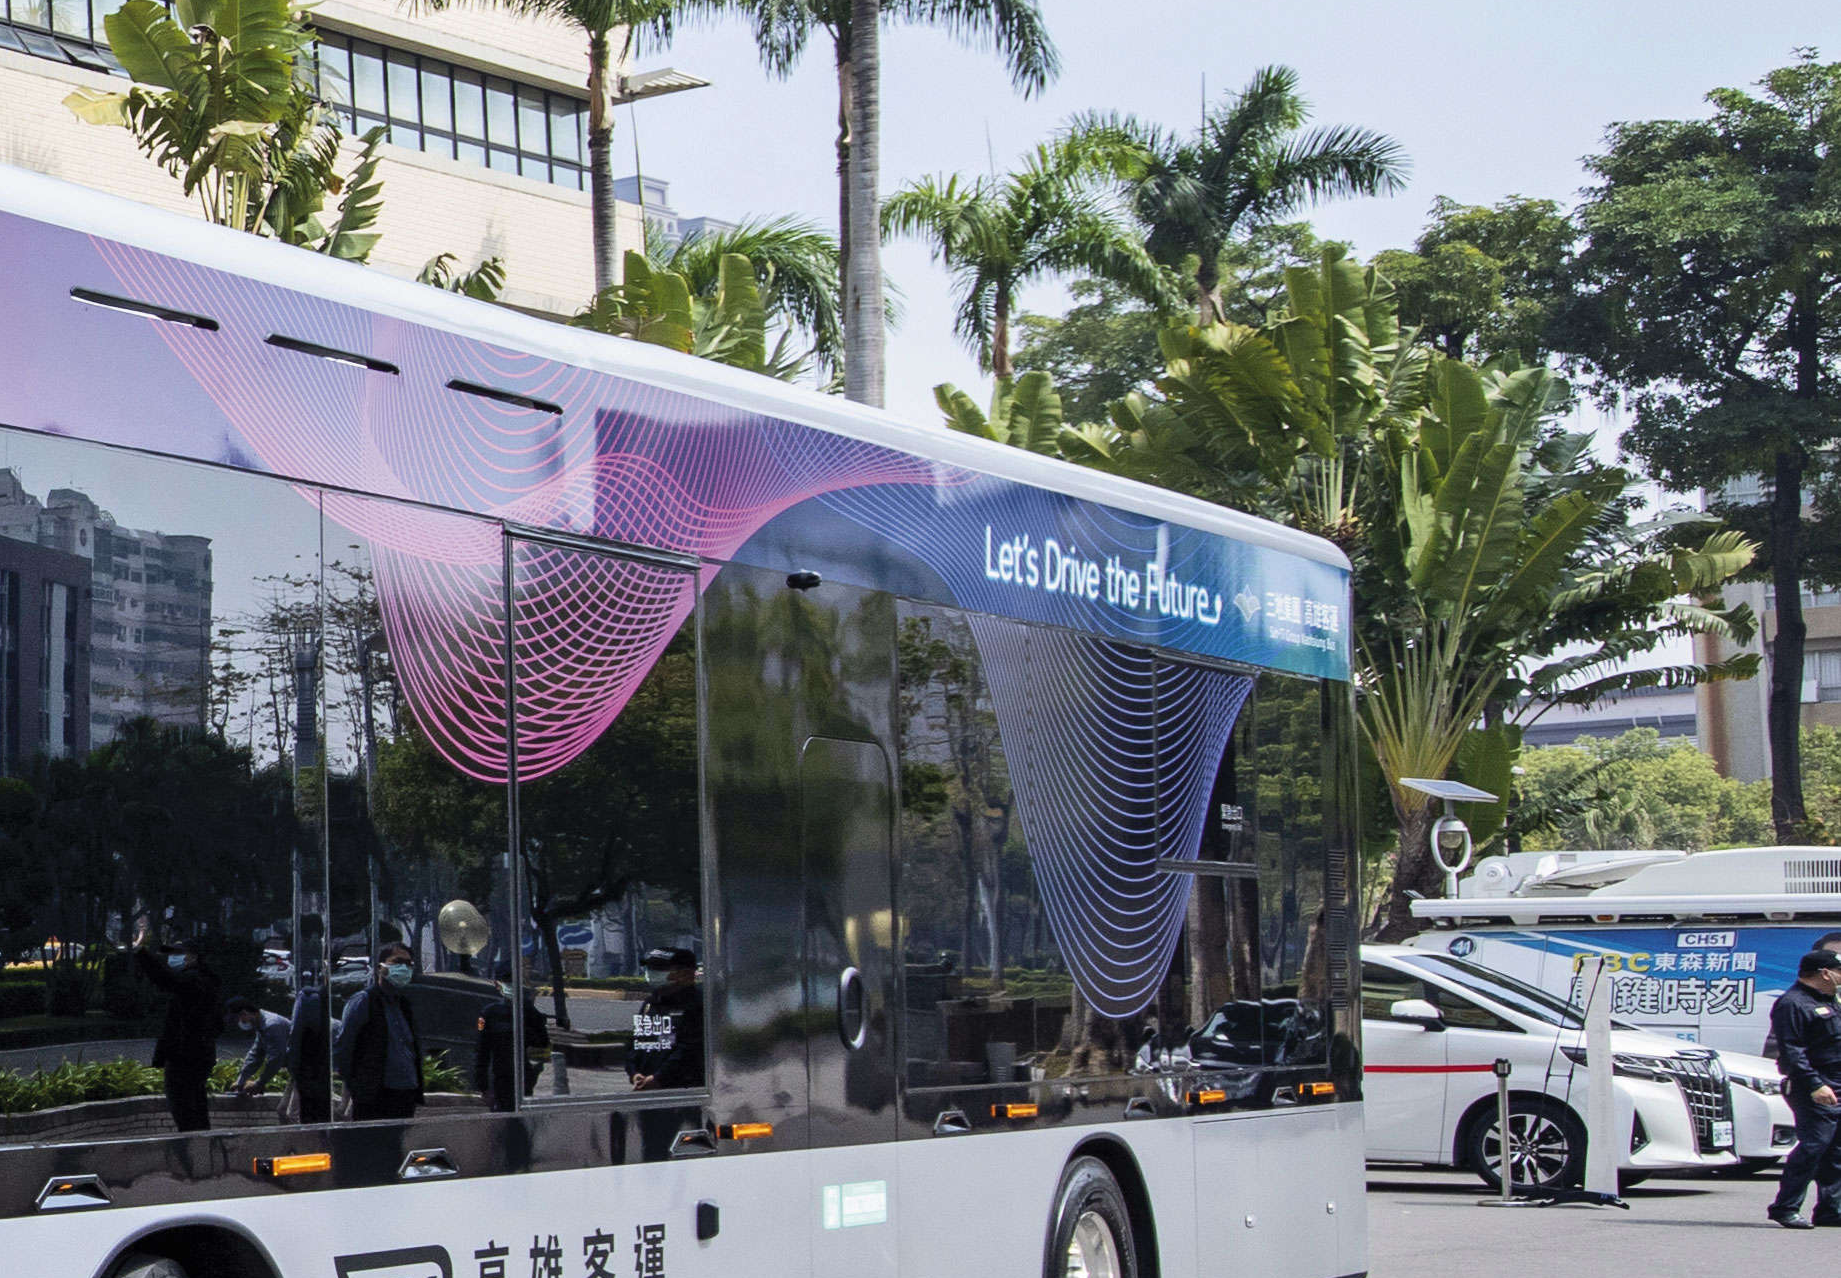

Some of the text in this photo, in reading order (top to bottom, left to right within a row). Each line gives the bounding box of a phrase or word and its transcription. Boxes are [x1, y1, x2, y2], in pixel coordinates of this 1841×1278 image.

[985, 525, 1222, 626] Let's Drive the Future
[1684, 931, 1727, 945] CH51
[1653, 952, 1757, 973] 東森新聞
